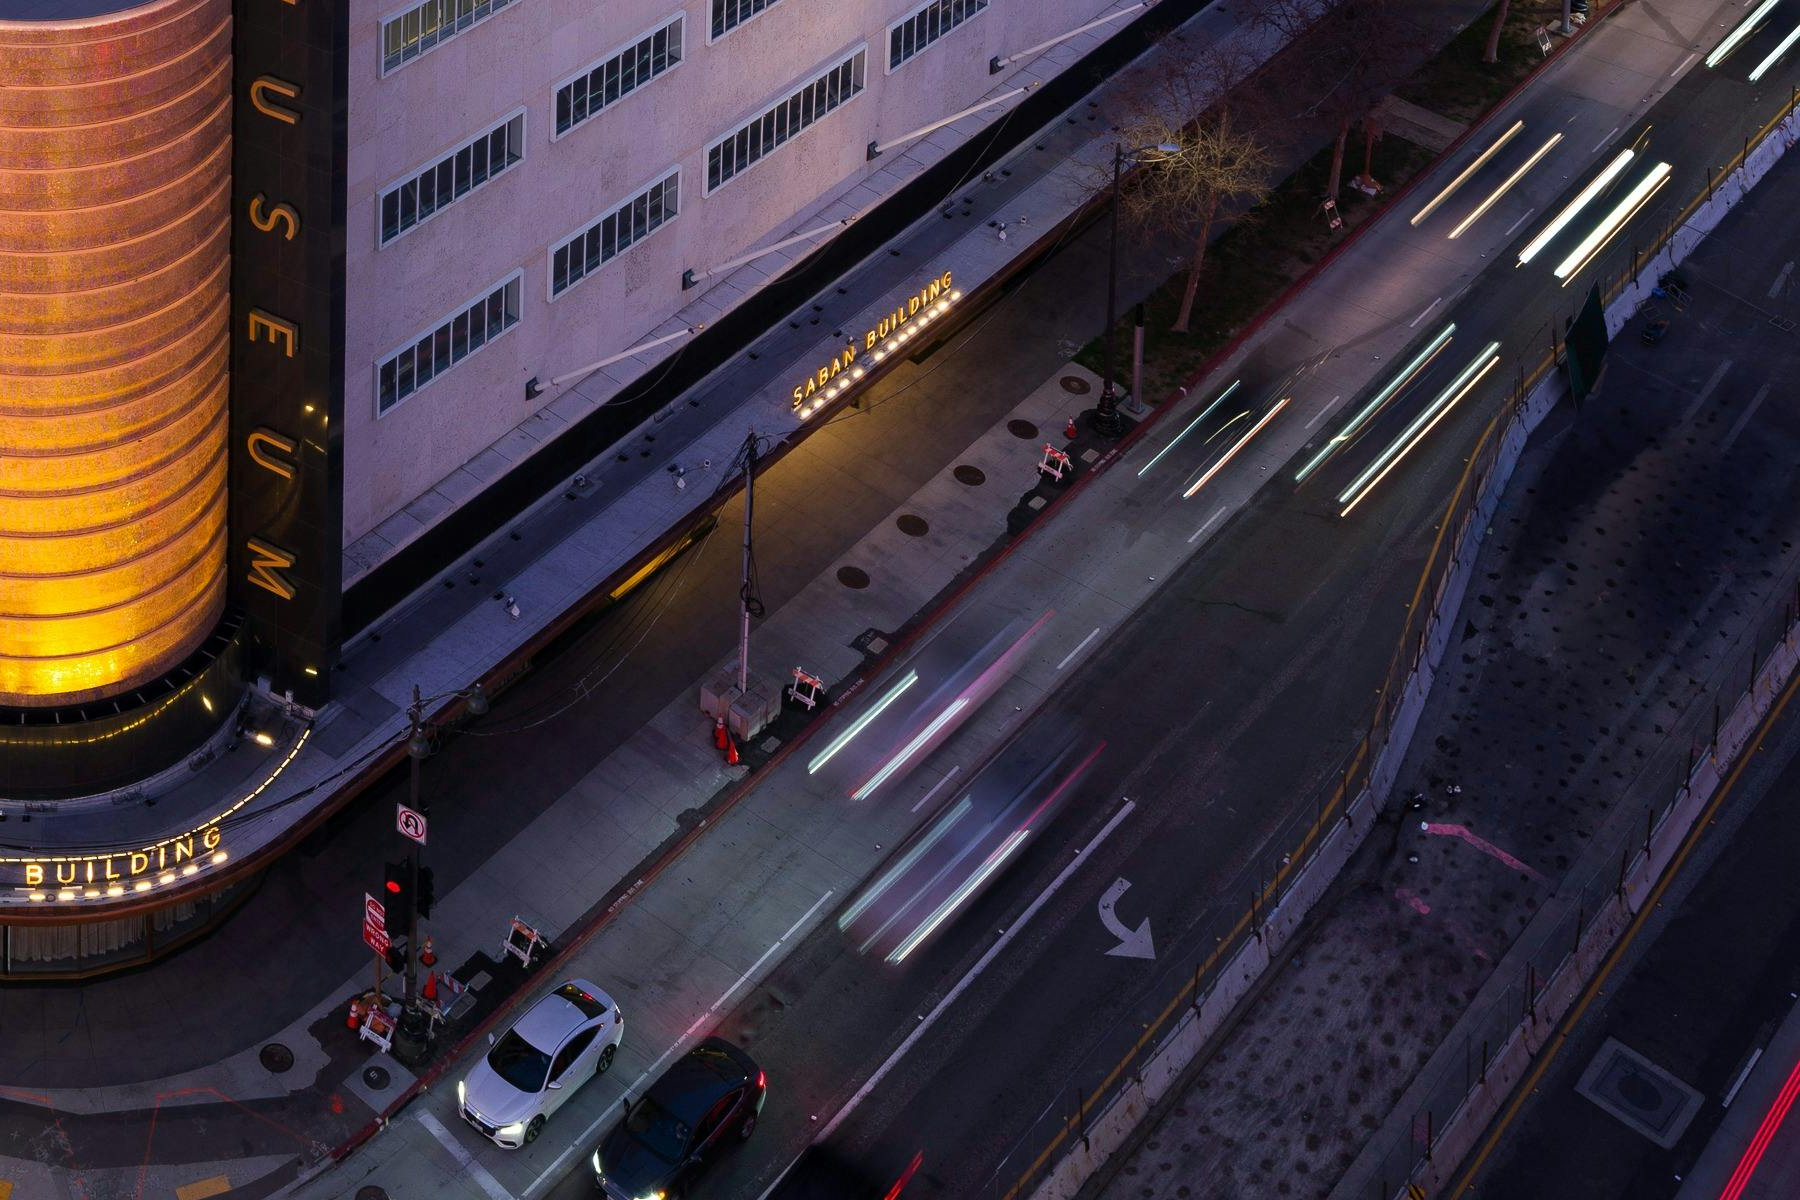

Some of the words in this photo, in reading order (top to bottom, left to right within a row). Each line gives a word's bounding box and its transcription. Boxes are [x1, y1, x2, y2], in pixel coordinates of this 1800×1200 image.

[793, 345, 856, 406] SABAN
[865, 271, 952, 350] BUILDING
[25, 826, 222, 886] BUILDING
[366, 923, 389, 947] WRONG
[370, 938, 385, 952] WAY
